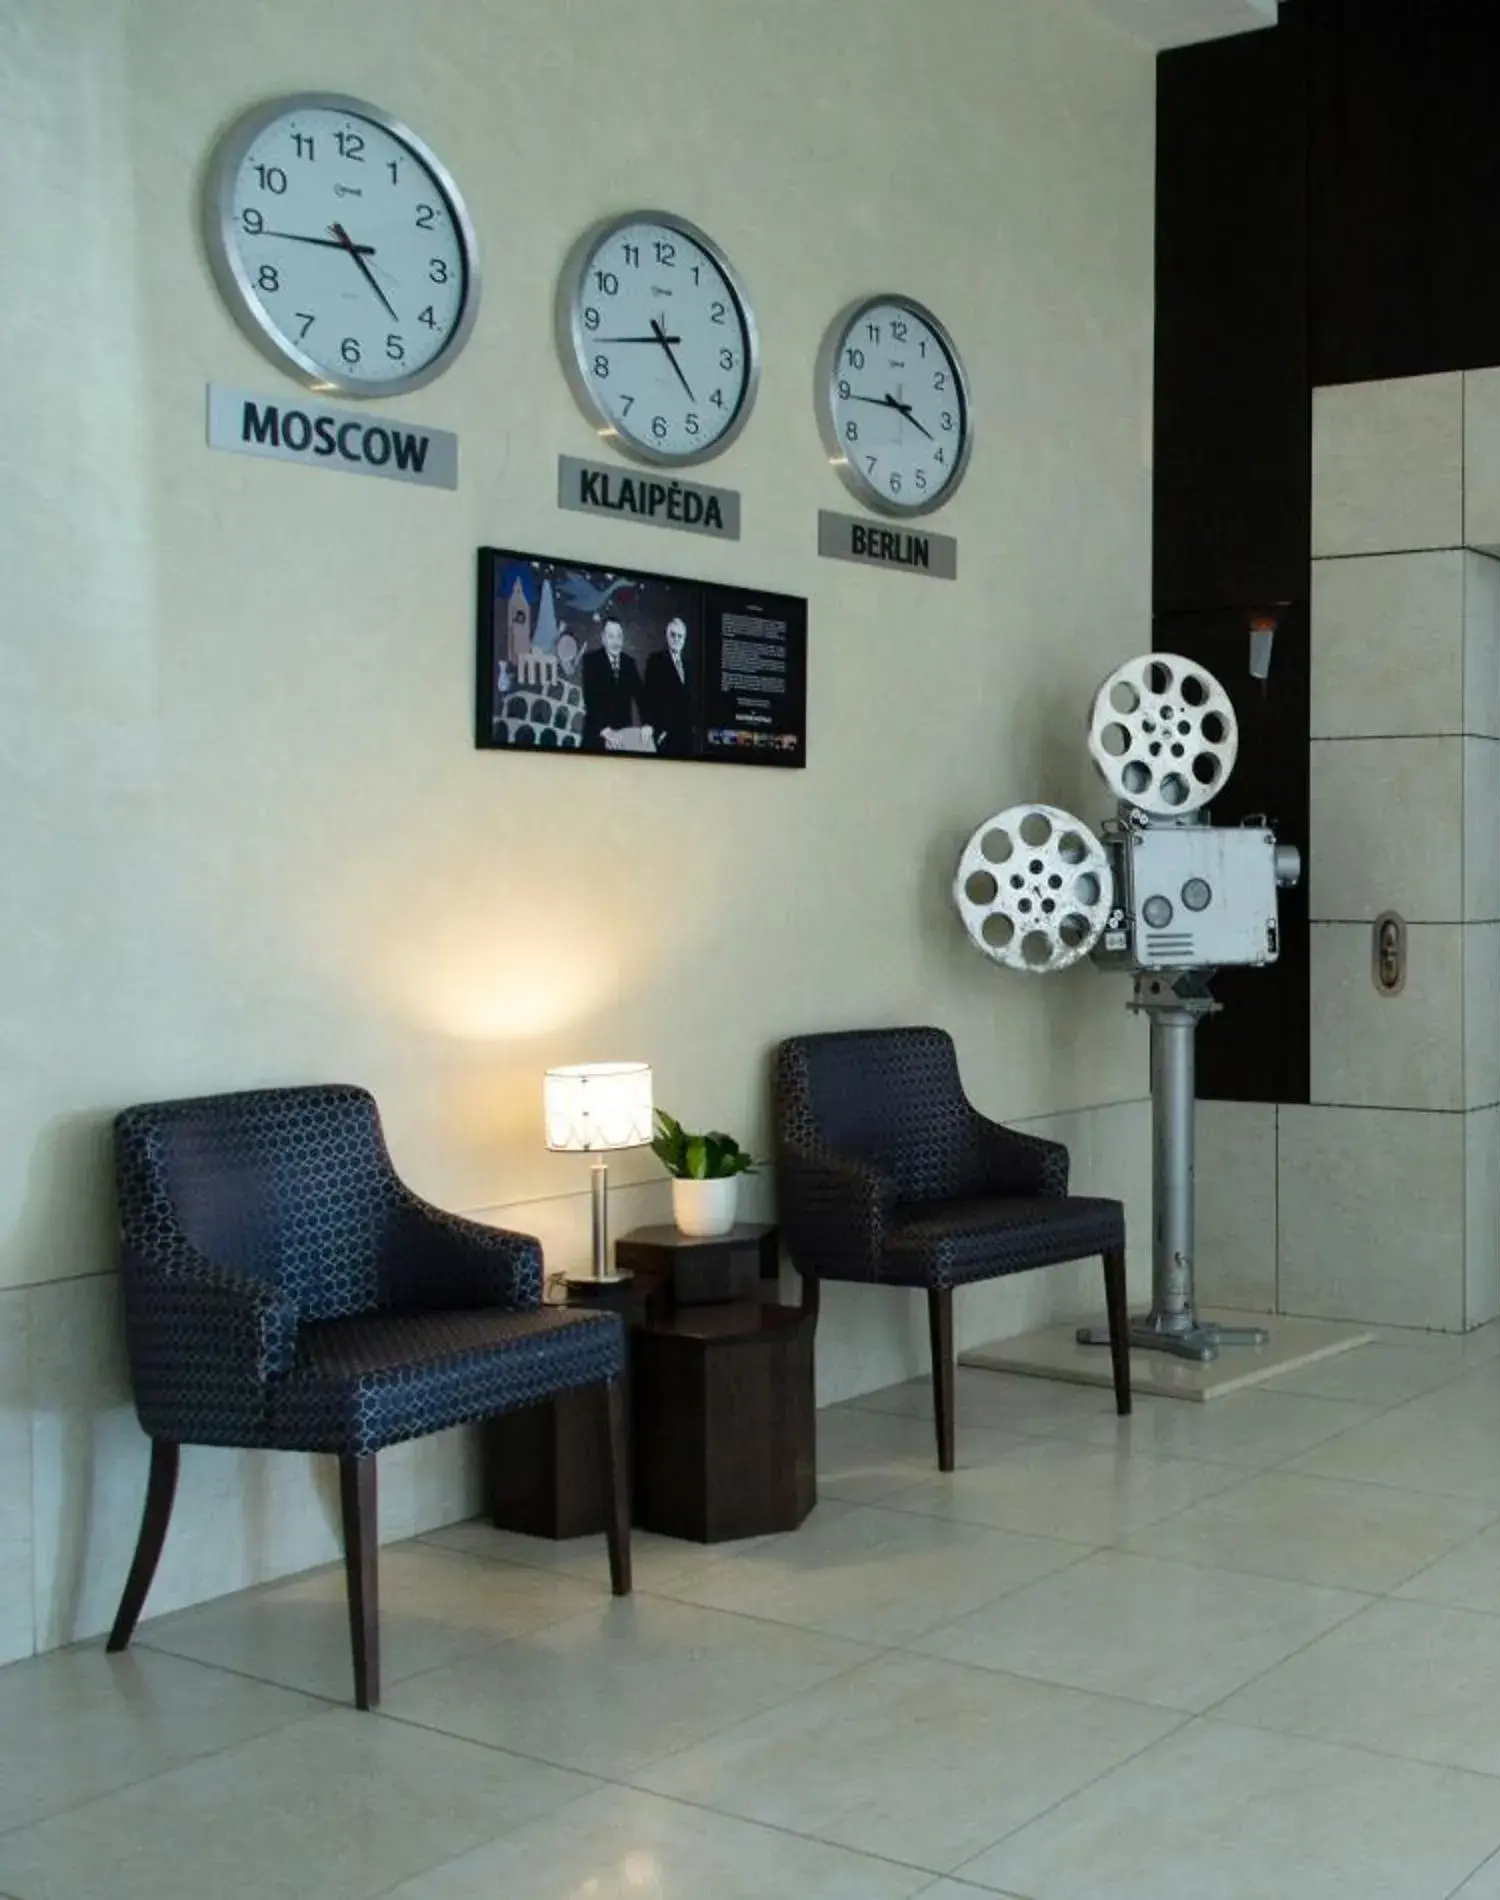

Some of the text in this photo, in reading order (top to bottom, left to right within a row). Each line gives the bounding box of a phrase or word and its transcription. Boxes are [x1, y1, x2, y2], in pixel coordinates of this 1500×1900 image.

[291, 133, 313, 160] 11
[334, 132, 364, 161] 12
[253, 163, 287, 194] 10
[387, 161, 399, 185] 1
[242, 208, 263, 235] 9
[416, 204, 434, 230] 2
[622, 244, 638, 268] 11
[654, 242, 675, 266] 12
[258, 265, 279, 292] 8
[430, 259, 448, 284] 3
[595, 271, 618, 295] 10
[692, 266, 699, 286] 1
[418, 305, 437, 330] 4
[584, 307, 600, 330] 9
[711, 302, 724, 324] 2
[296, 313, 315, 338] 7
[867, 323, 880, 344] 11
[890, 321, 907, 343] 12
[341, 338, 361, 364] 6
[386, 335, 404, 361] 5
[847, 349, 864, 370] 10
[919, 340, 927, 358] 1
[594, 355, 608, 378] 8
[720, 349, 733, 371] 3
[838, 380, 851, 400] 9
[934, 372, 945, 391] 2
[620, 395, 634, 416] 7
[710, 389, 723, 408] 4
[652, 416, 666, 438] 6
[685, 413, 699, 435] 5
[846, 421, 858, 442] 8
[941, 412, 952, 430] 3
[242, 401, 429, 473] MOSCOW
[866, 456, 877, 475] 7
[934, 448, 944, 464] 4
[890, 473, 901, 494] 6
[916, 469, 927, 489] 5
[580, 469, 724, 530] KLAIPĖDA
[852, 525, 929, 569] BERLIN
